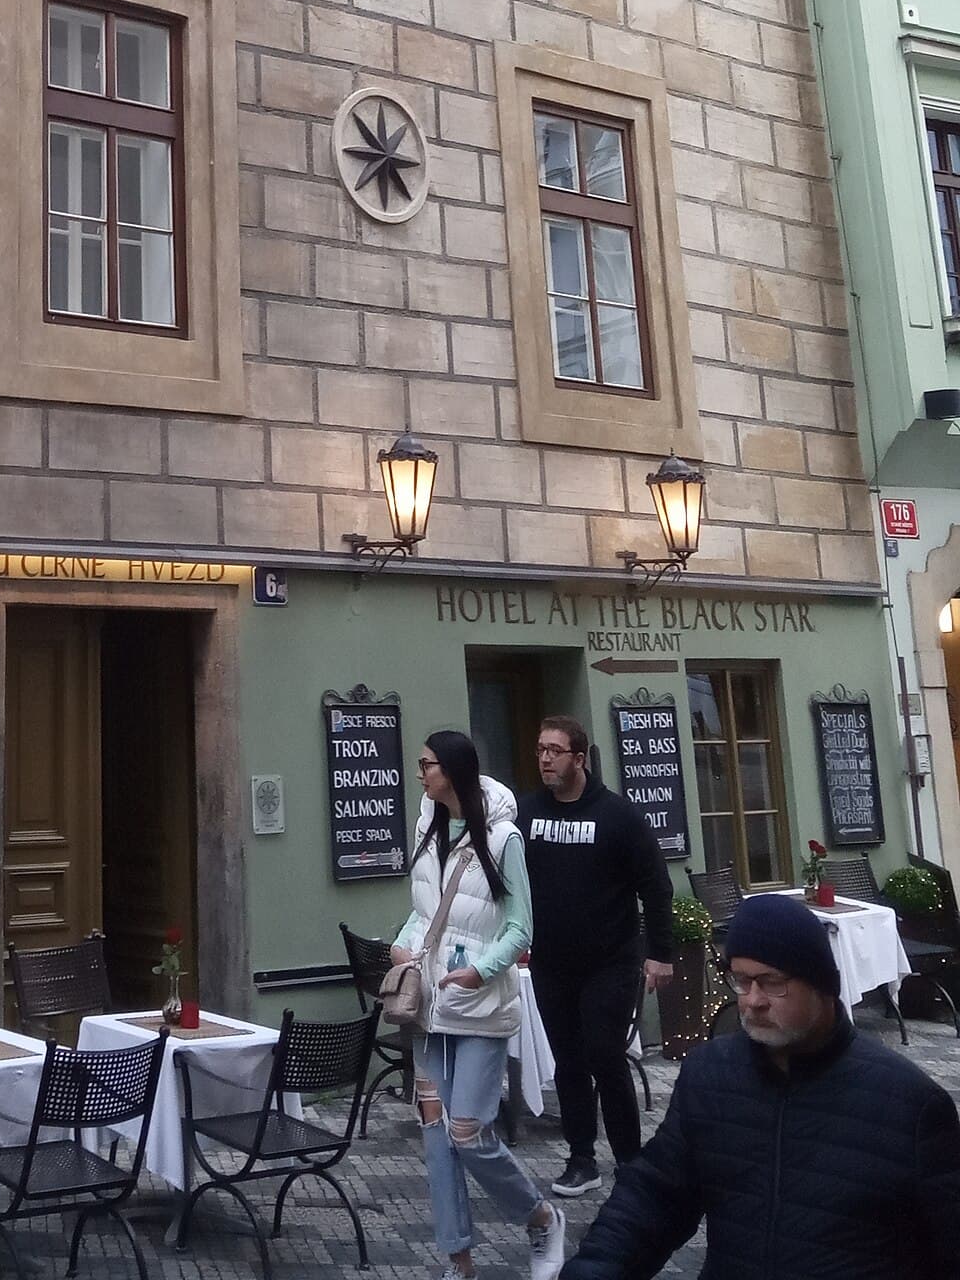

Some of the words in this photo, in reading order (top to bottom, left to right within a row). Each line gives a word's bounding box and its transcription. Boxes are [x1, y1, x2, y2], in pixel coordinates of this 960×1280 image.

[890, 503, 910, 521] 176
[436, 586, 536, 625] HOTEL
[548, 591, 582, 626] AT
[592, 595, 650, 629] THE
[660, 595, 745, 632] BLACK
[753, 600, 817, 633] STAR
[587, 631, 682, 652] RESTAURANT
[331, 710, 363, 732] PESCE
[365, 715, 396, 728] FRESCO
[619, 711, 652, 732] FRESH
[653, 712, 674, 728] FISH
[332, 740, 379, 758] TROTA
[622, 739, 643, 755] SEA
[648, 737, 677, 754] BASS
[334, 769, 400, 788] BRANZINO
[624, 763, 679, 779] SWORDFISH
[626, 787, 673, 804] SALMON
[334, 798, 395, 819] SALMONE
[645, 811, 669, 829] OUT
[336, 829, 363, 843] PESCE
[366, 828, 393, 841] SPADA
[530, 818, 596, 844] PUMA
